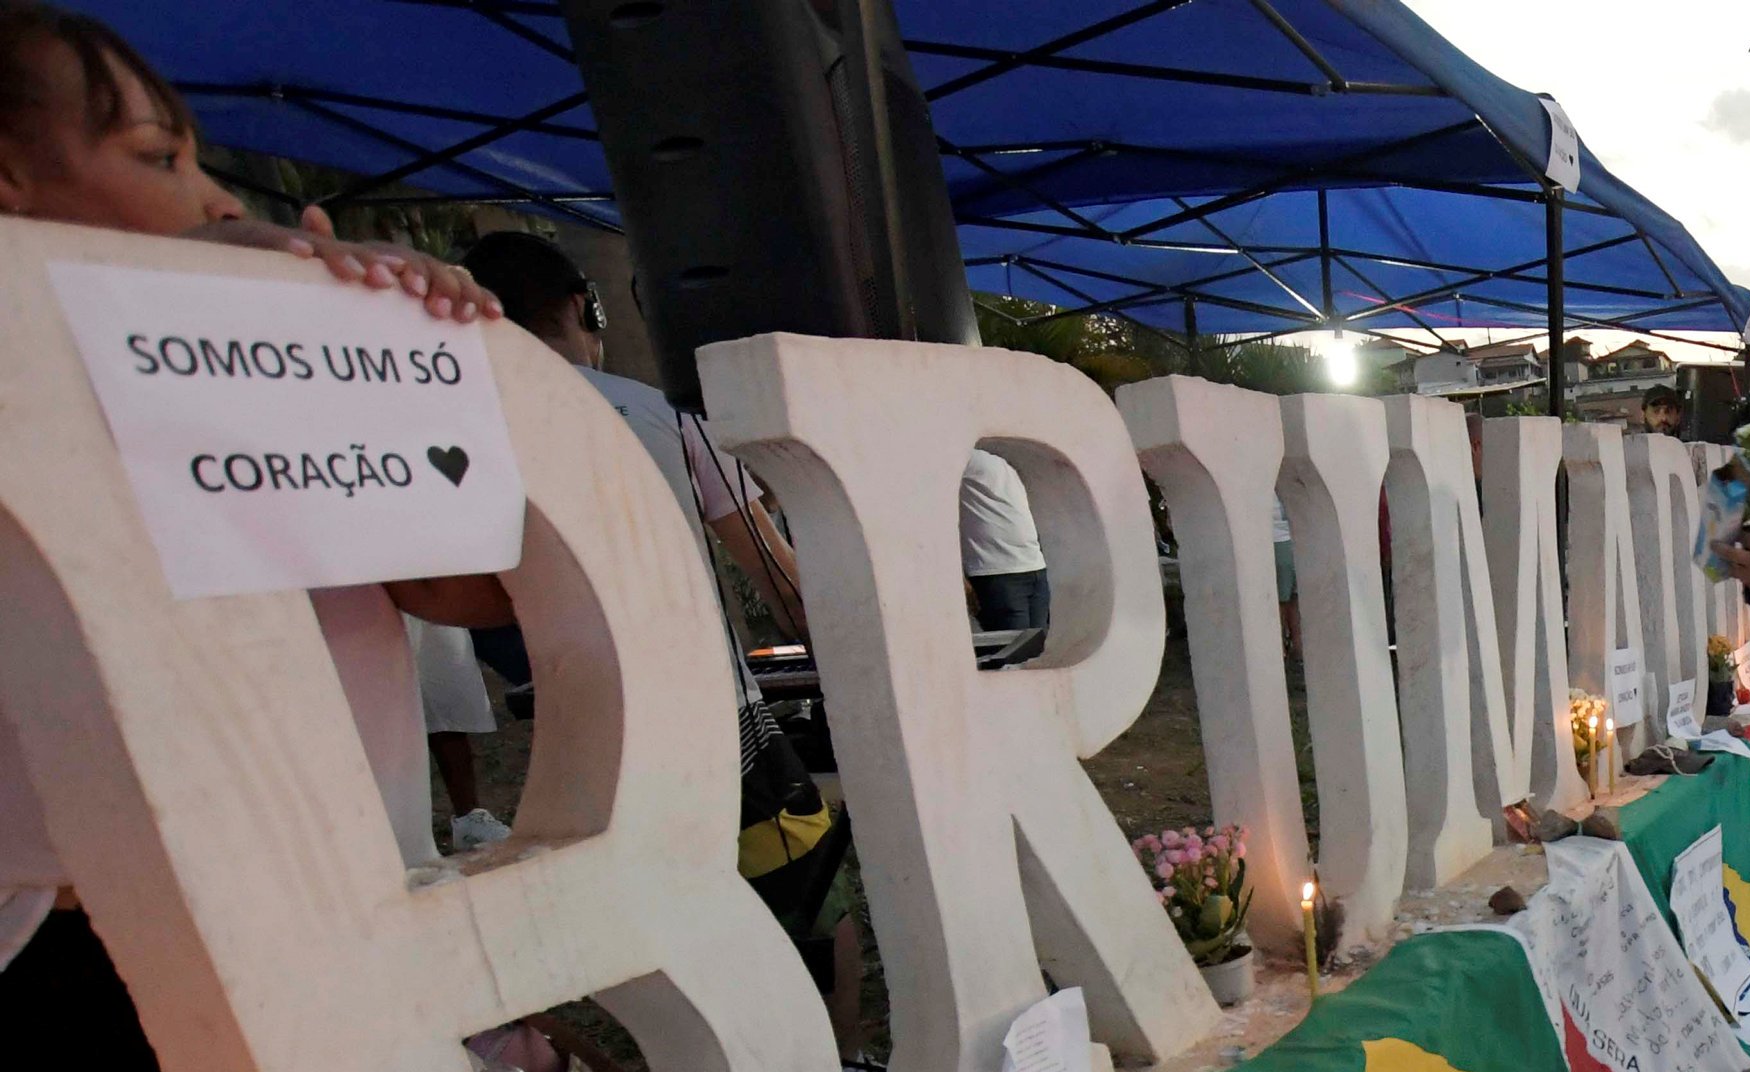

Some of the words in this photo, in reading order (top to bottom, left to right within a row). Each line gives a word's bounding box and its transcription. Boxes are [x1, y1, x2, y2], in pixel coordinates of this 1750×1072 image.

[127, 333, 314, 381] SOMOS
[321, 344, 401, 384] UM
[415, 342, 462, 386] SÓ
[190, 444, 413, 499] CORAÇÃO
